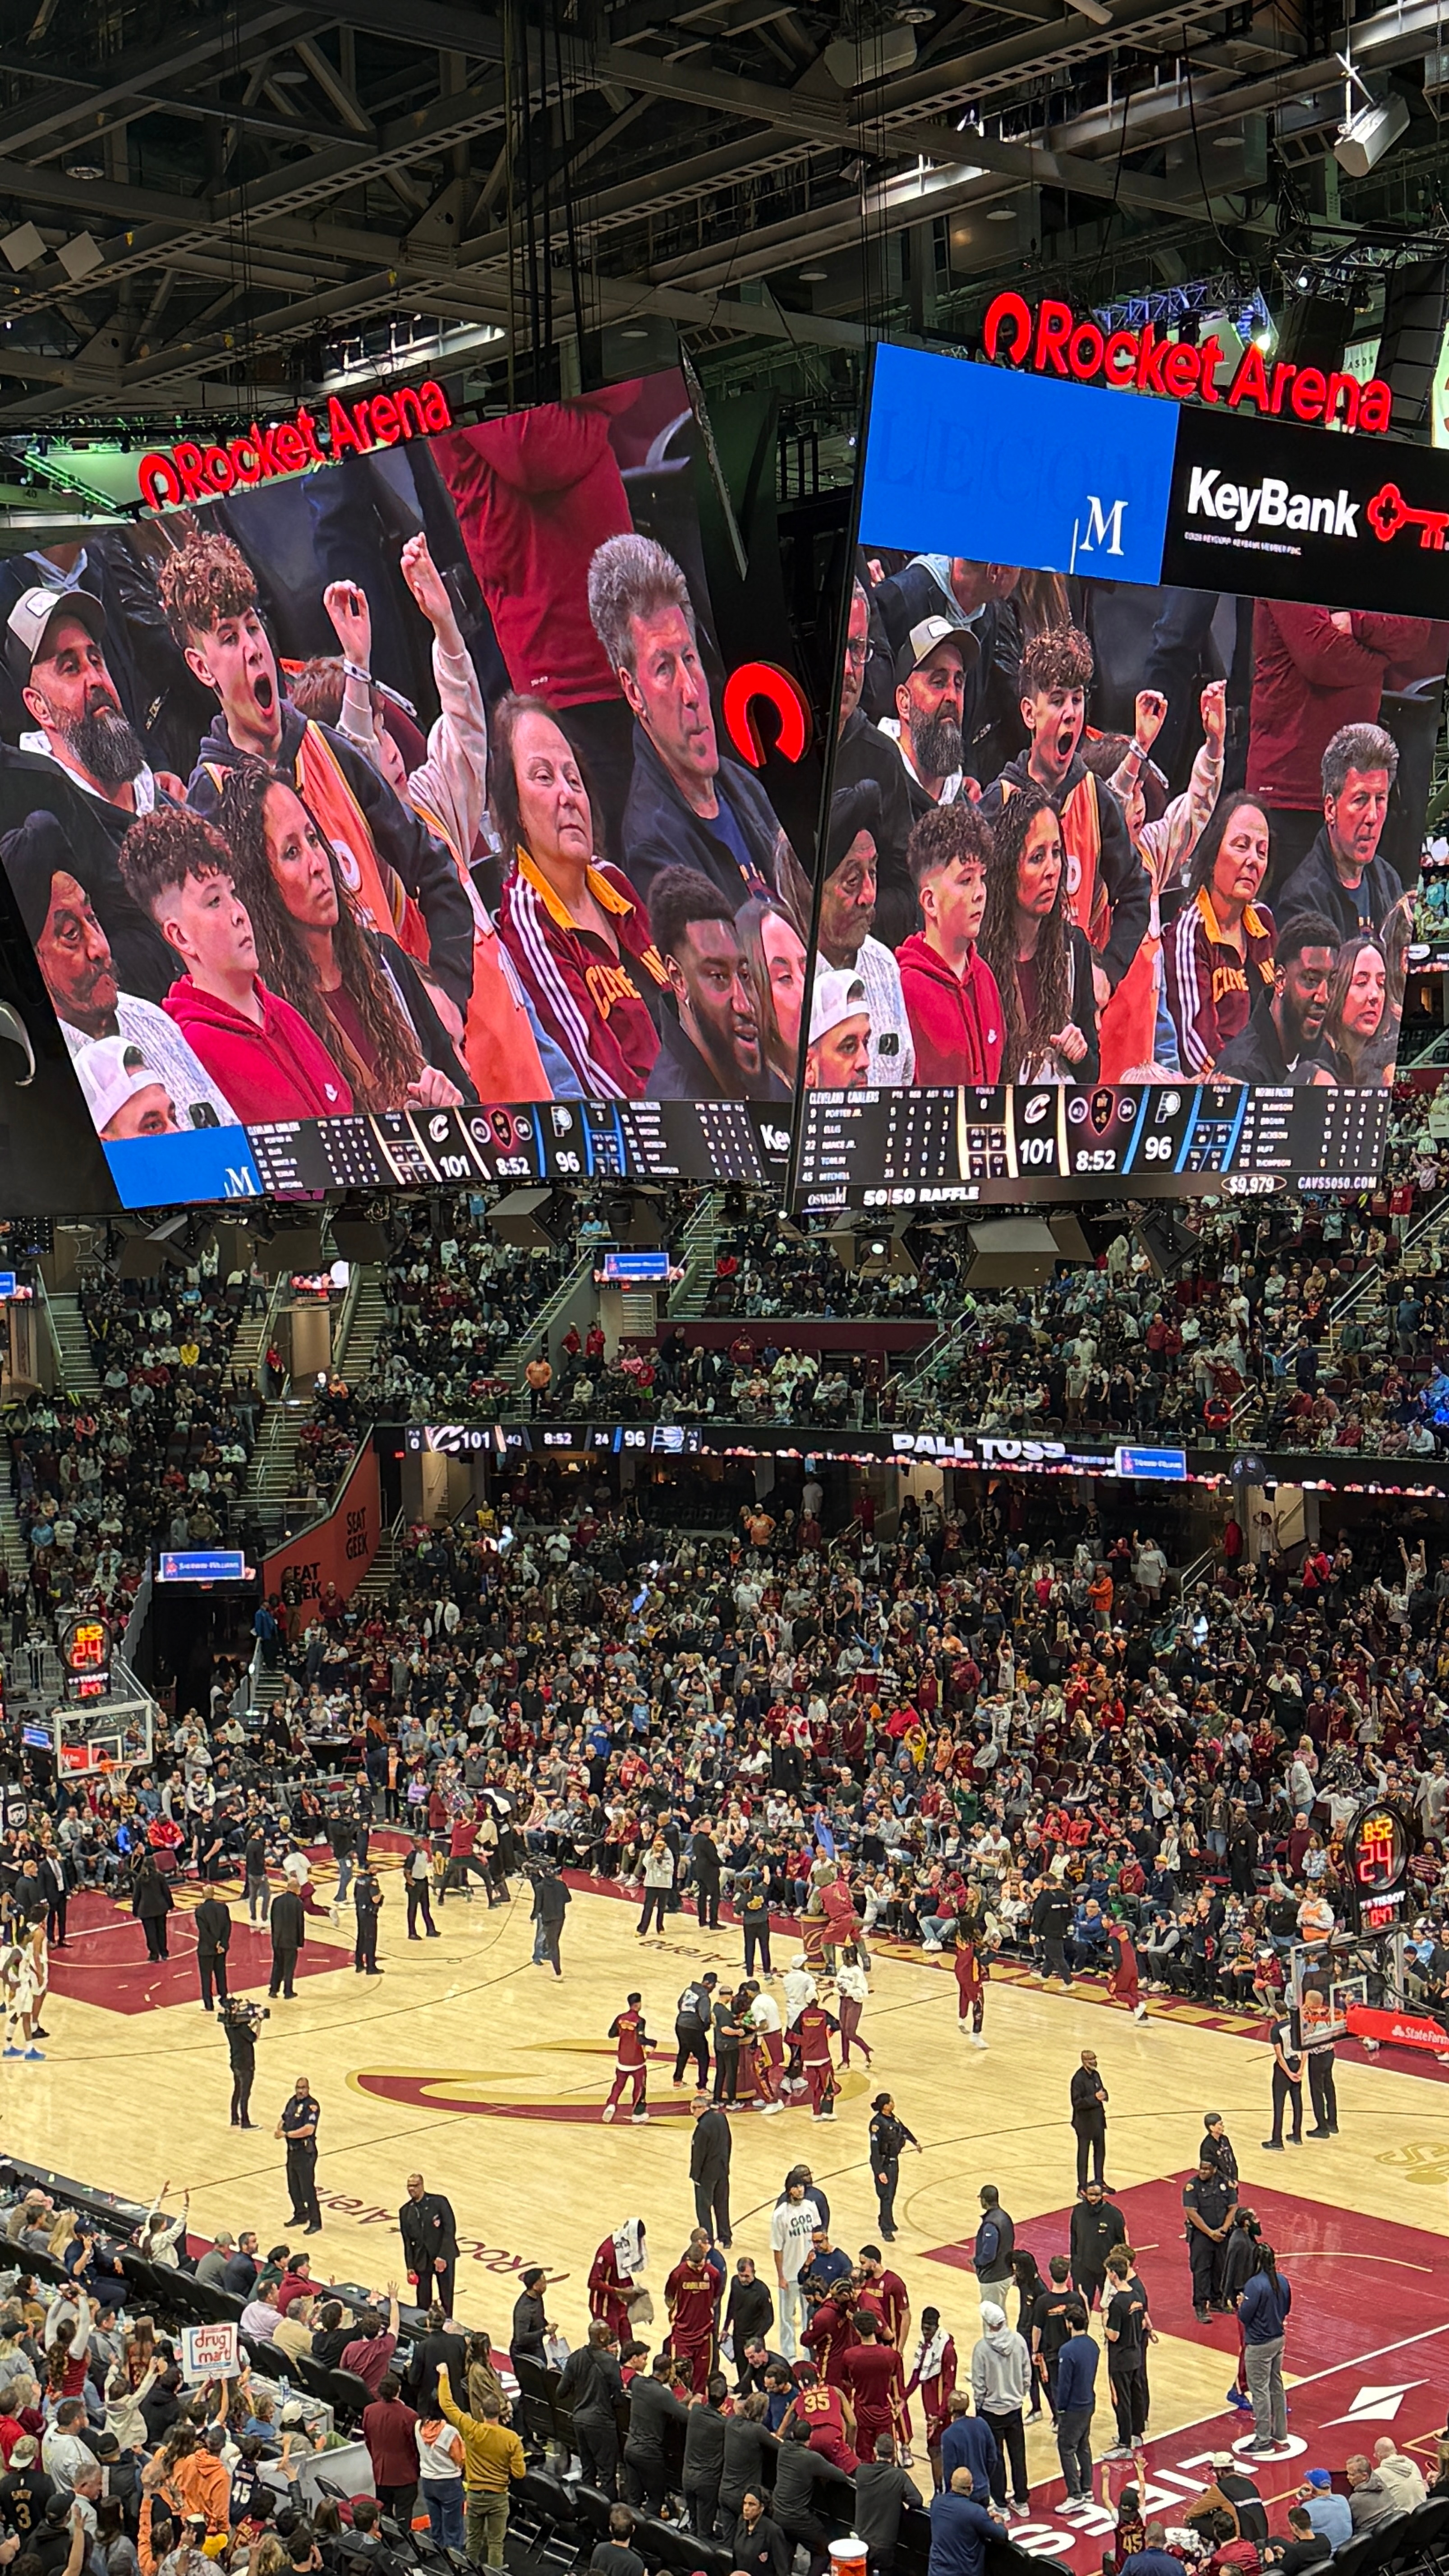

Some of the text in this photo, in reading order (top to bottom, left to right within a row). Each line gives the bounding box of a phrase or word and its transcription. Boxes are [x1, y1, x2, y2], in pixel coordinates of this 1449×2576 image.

[1035, 299, 1393, 433] Rocket Arena
[172, 380, 452, 502] Rocket Arena
[1187, 466, 1360, 538] KeyBank
[1019, 1138, 1054, 1164] 101
[1145, 1136, 1172, 1160] 96
[440, 1155, 471, 1178] 101
[496, 1156, 531, 1176] 8:52
[555, 1151, 581, 1173] 96
[1076, 1150, 1116, 1171] 8:52
[1229, 1176, 1275, 1196] $9,979
[1297, 1176, 1377, 1190] CAVS5050.COM
[808, 1186, 847, 1206] oswald
[920, 1187, 980, 1202] RAFFLE
[461, 1431, 490, 1449] 101
[544, 1432, 573, 1444] 8:52
[595, 1433, 609, 1445] 24
[624, 1431, 646, 1447] 96
[347, 1507, 366, 1536] SEAT
[345, 1532, 369, 1559] GEEK
[304, 1581, 322, 1600] EK
[73, 1640, 102, 1667] 24
[1359, 1840, 1392, 1882] 24
[1373, 1890, 1406, 1907] TISSOT
[194, 2329, 226, 2350] drug
[198, 2348, 231, 2364] mart
[804, 2393, 830, 2413] 35
[16, 2503, 32, 2529] 3
[1122, 2534, 1143, 2554] 45
